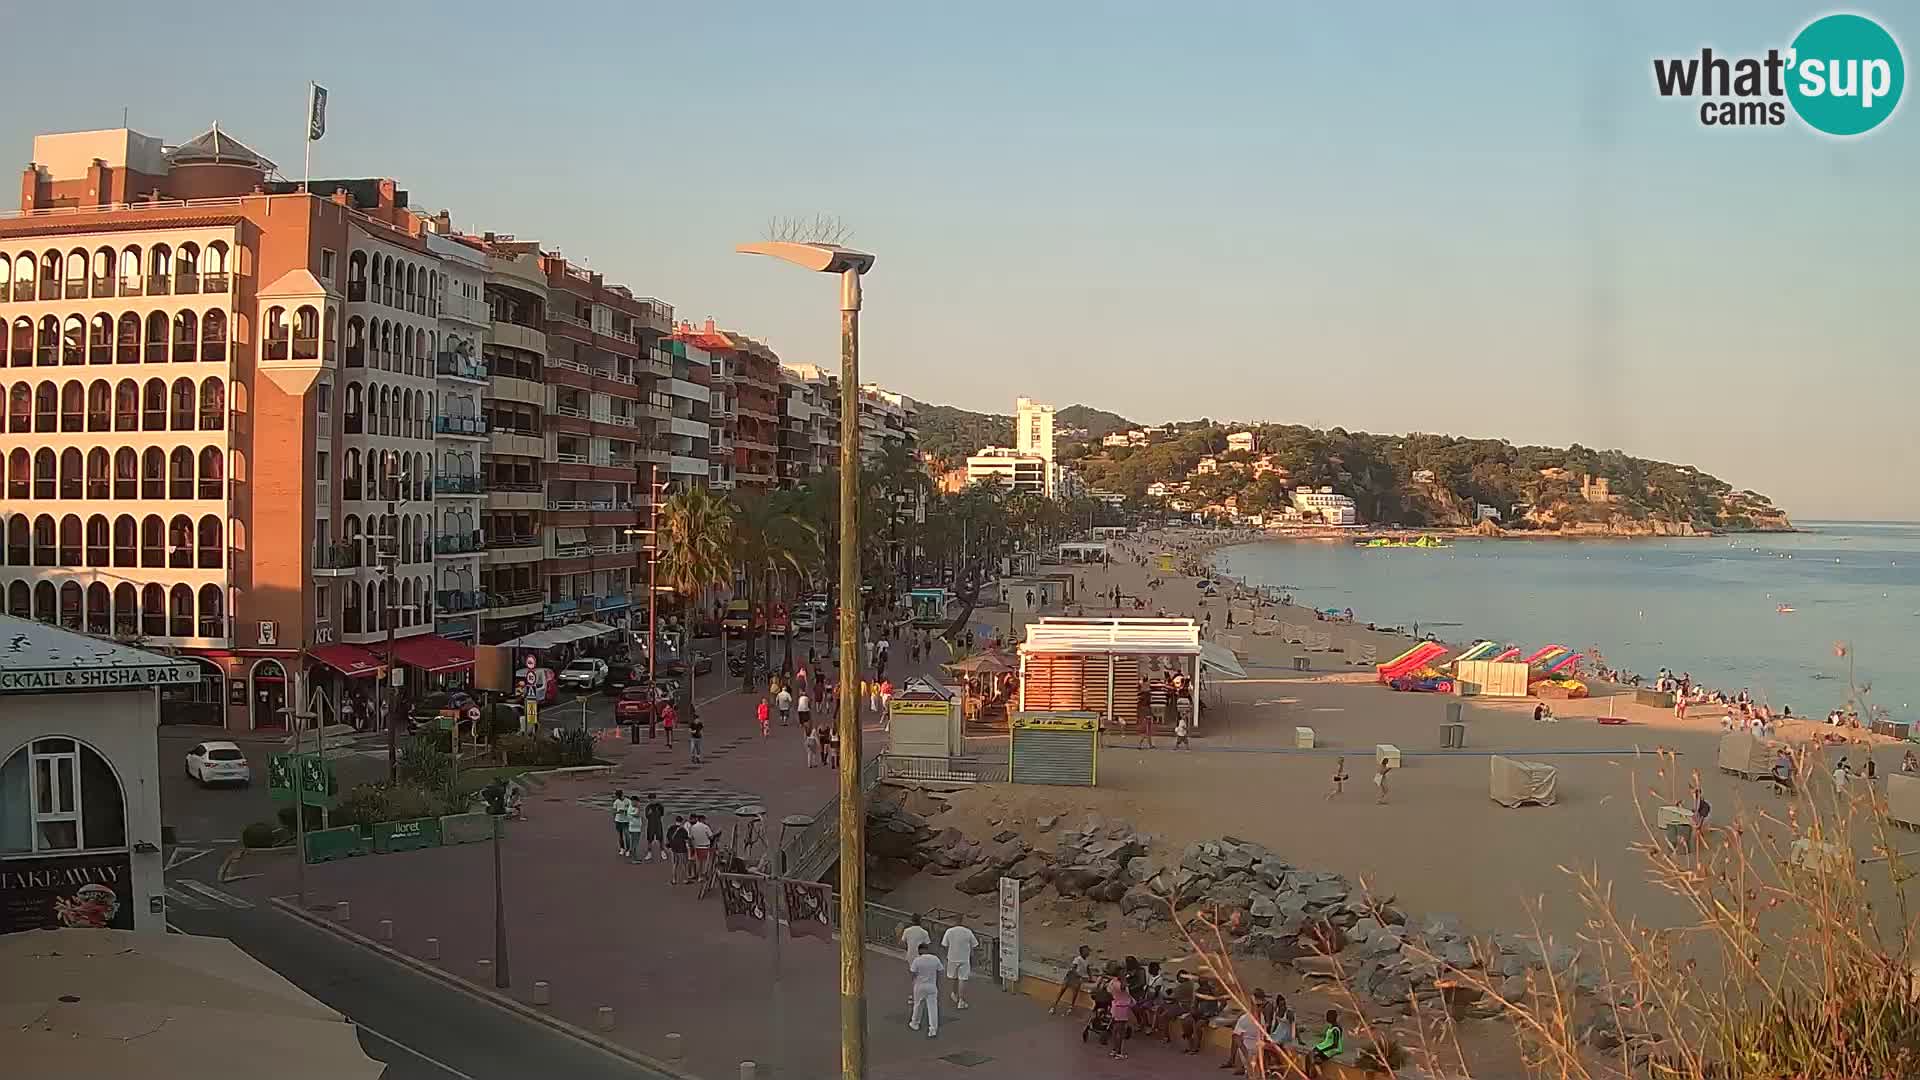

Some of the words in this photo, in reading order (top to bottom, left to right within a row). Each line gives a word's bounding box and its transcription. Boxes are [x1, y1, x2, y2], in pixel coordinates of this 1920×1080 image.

[314, 627, 334, 645] KFC
[64, 671, 76, 686] &
[79, 669, 143, 686] SHISHA
[147, 667, 180, 683] BAR
